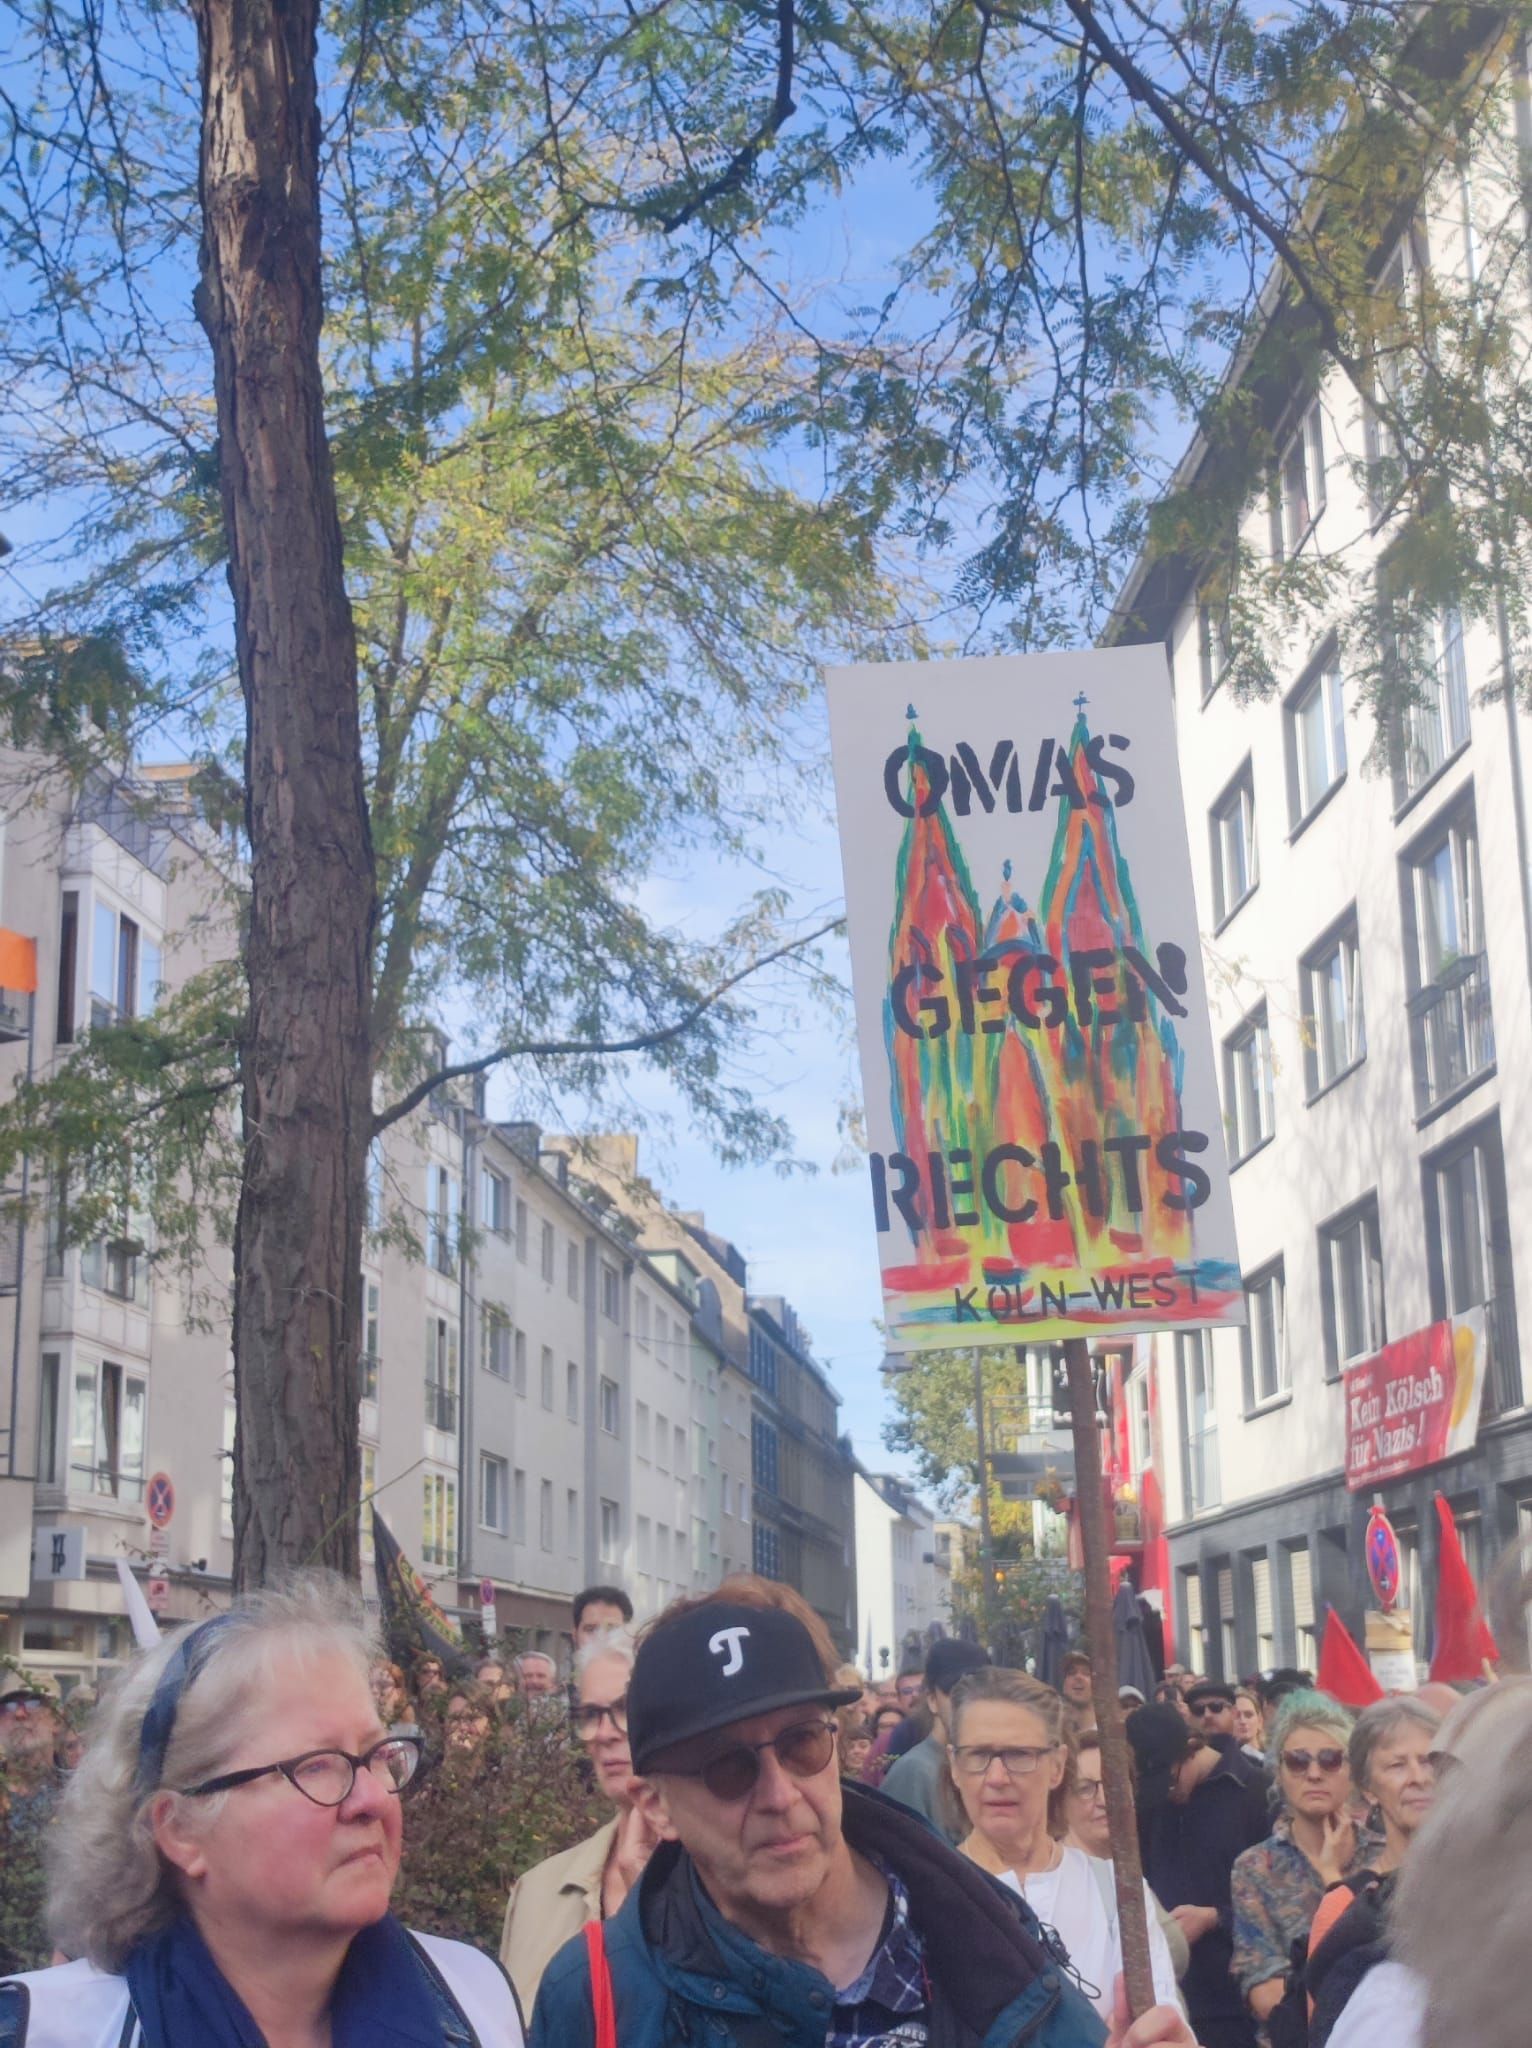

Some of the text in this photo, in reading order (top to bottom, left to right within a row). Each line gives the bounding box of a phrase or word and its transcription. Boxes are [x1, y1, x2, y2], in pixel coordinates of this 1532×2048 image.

[883, 733, 1135, 818] OMAS
[892, 942, 1188, 1039] GEGEN
[869, 1130, 1211, 1232] RECHTS
[1351, 1392, 1381, 1431] Kein
[1385, 1366, 1444, 1417] Kölsch
